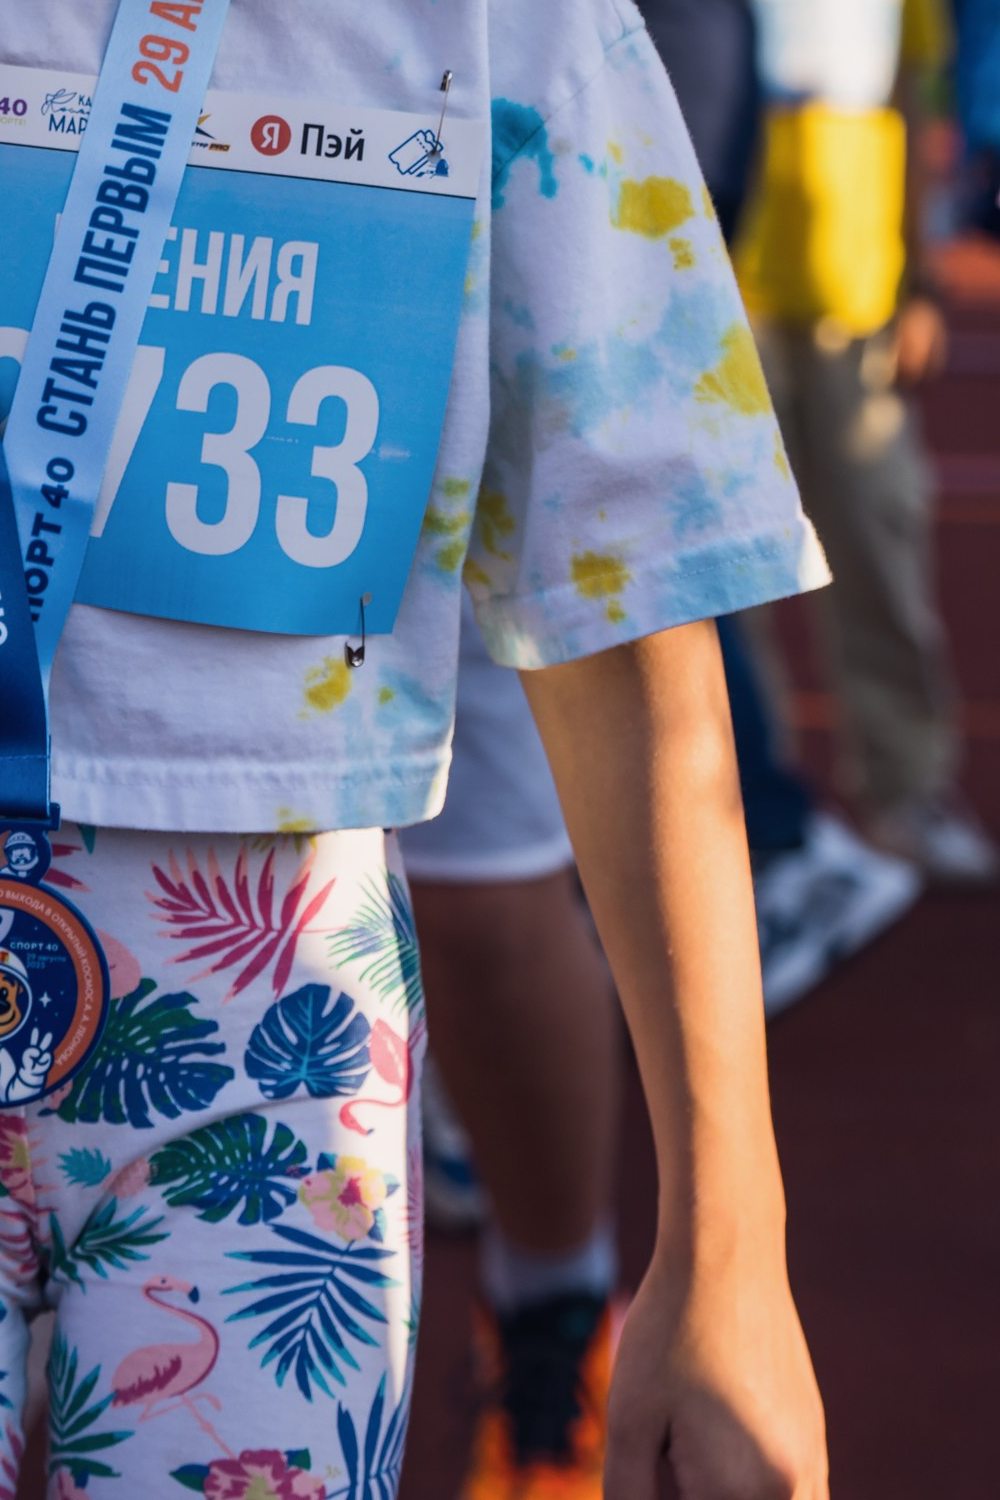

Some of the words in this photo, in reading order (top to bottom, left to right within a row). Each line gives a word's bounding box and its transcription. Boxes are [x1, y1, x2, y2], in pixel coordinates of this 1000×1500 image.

[131, 34, 190, 93] 29
[300, 122, 366, 162] Пэй
[73, 102, 172, 294] ПЕРВЫМ
[36, 301, 117, 438] СТАНЬ
[40, 457, 75, 509] 40
[5, 890, 45, 912] ВЫХОДА
[10, 941, 43, 951] СПОРТ
[46, 943, 59, 952] 40
